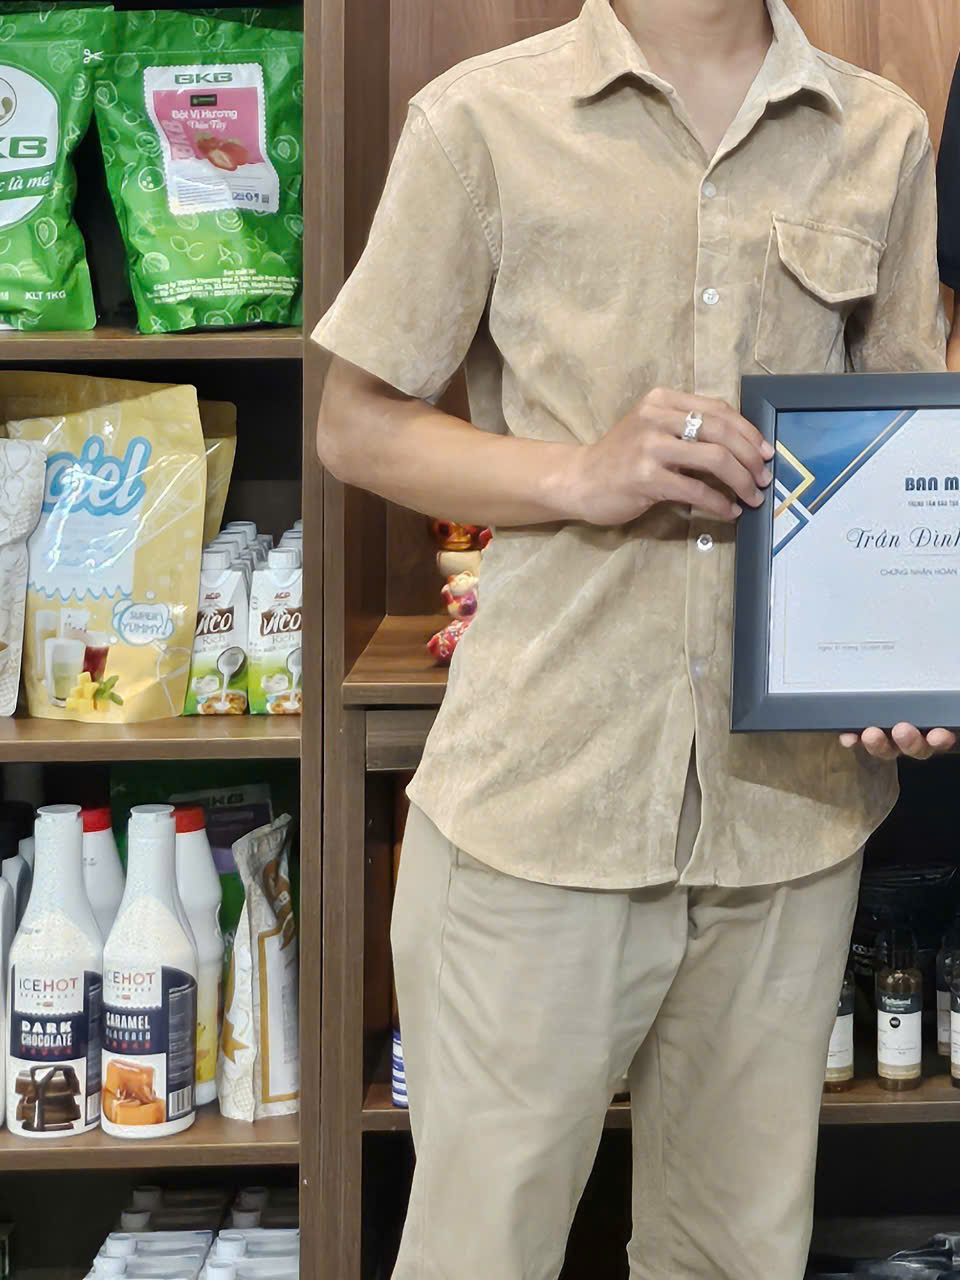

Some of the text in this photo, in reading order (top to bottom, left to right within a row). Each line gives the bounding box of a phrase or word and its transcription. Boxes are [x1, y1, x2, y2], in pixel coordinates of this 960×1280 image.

[174, 72, 233, 85] BKB
[8, 175, 24, 191] là
[25, 289, 67, 300] KLT 1KG
[904, 476, 938, 491] BAN
[19, 976, 79, 992] ICEHOT
[21, 1020, 72, 1034] DARK
[106, 1011, 150, 1030] CARAMEL
[21, 1033, 72, 1047] CHOCOLATE
